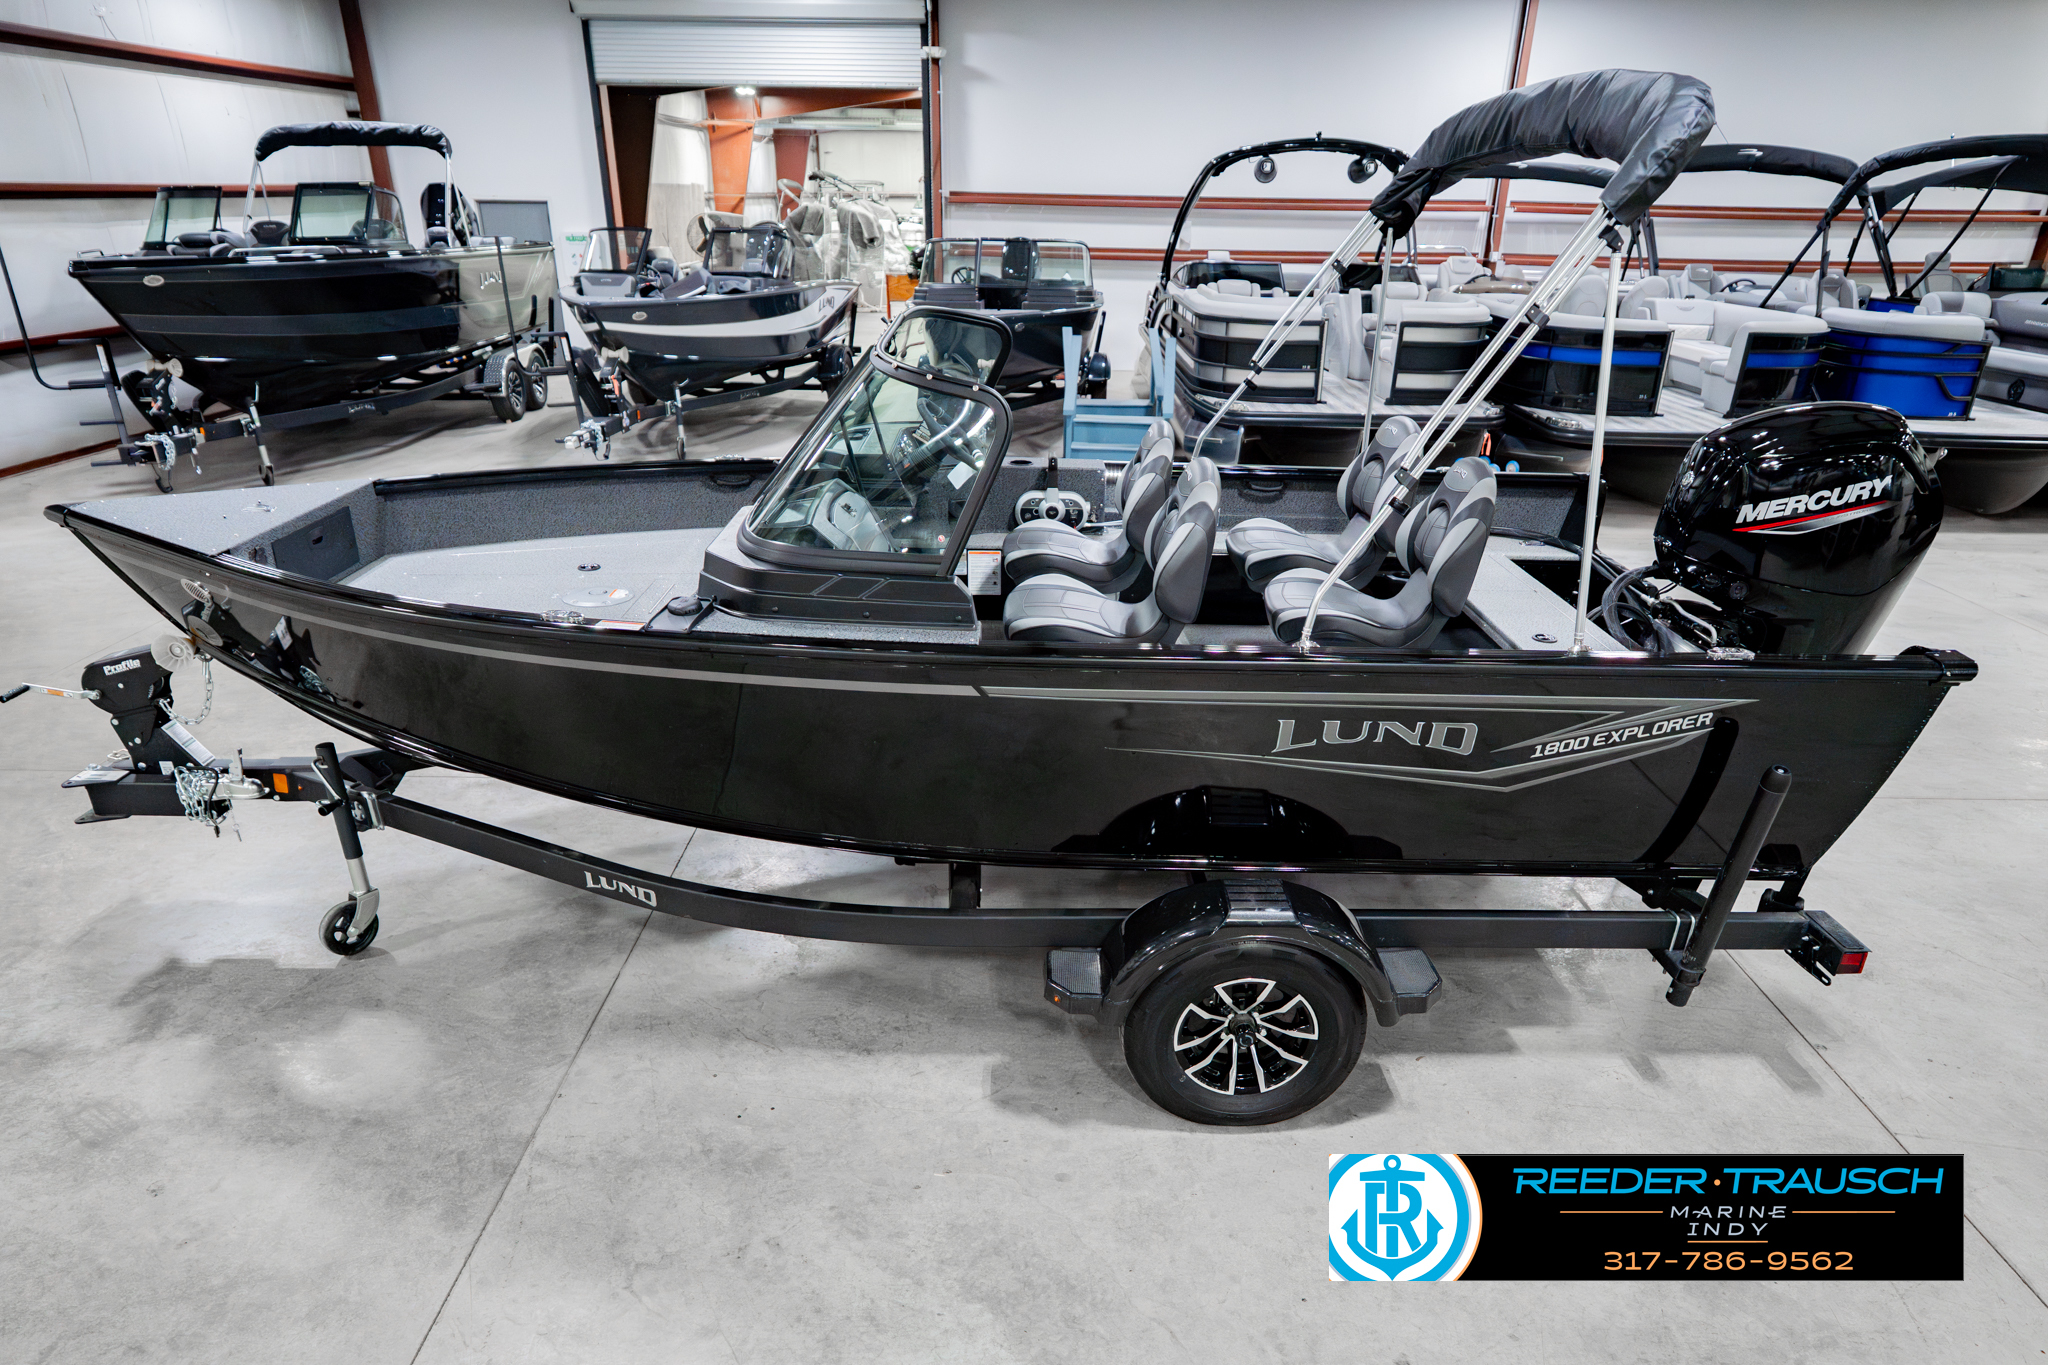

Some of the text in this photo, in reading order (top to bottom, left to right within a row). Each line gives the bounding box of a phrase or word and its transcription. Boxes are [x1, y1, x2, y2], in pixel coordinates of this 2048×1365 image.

[480, 271, 503, 290] LUN
[1736, 475, 1893, 524] MERCURY
[103, 659, 141, 674] Profile
[1271, 719, 1478, 756] LUND
[1530, 712, 1714, 759] 1800 EXPLORER
[584, 870, 658, 908] LUND
